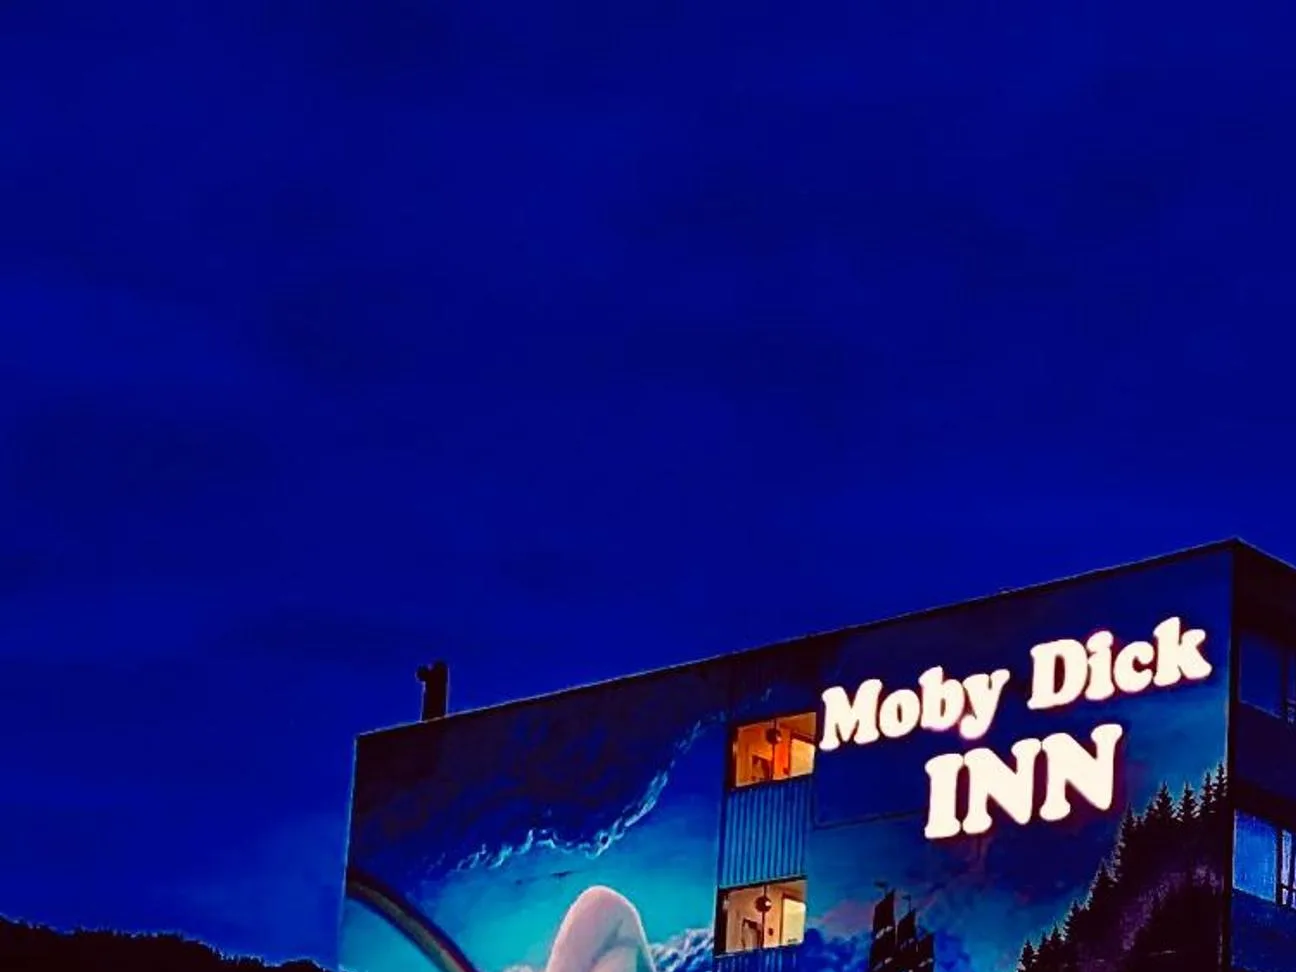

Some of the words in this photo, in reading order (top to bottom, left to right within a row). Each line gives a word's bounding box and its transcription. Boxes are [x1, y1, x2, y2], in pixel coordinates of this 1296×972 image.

[819, 666, 1010, 751] Moby
[1027, 617, 1212, 709] Dick
[924, 724, 1122, 838] INN
